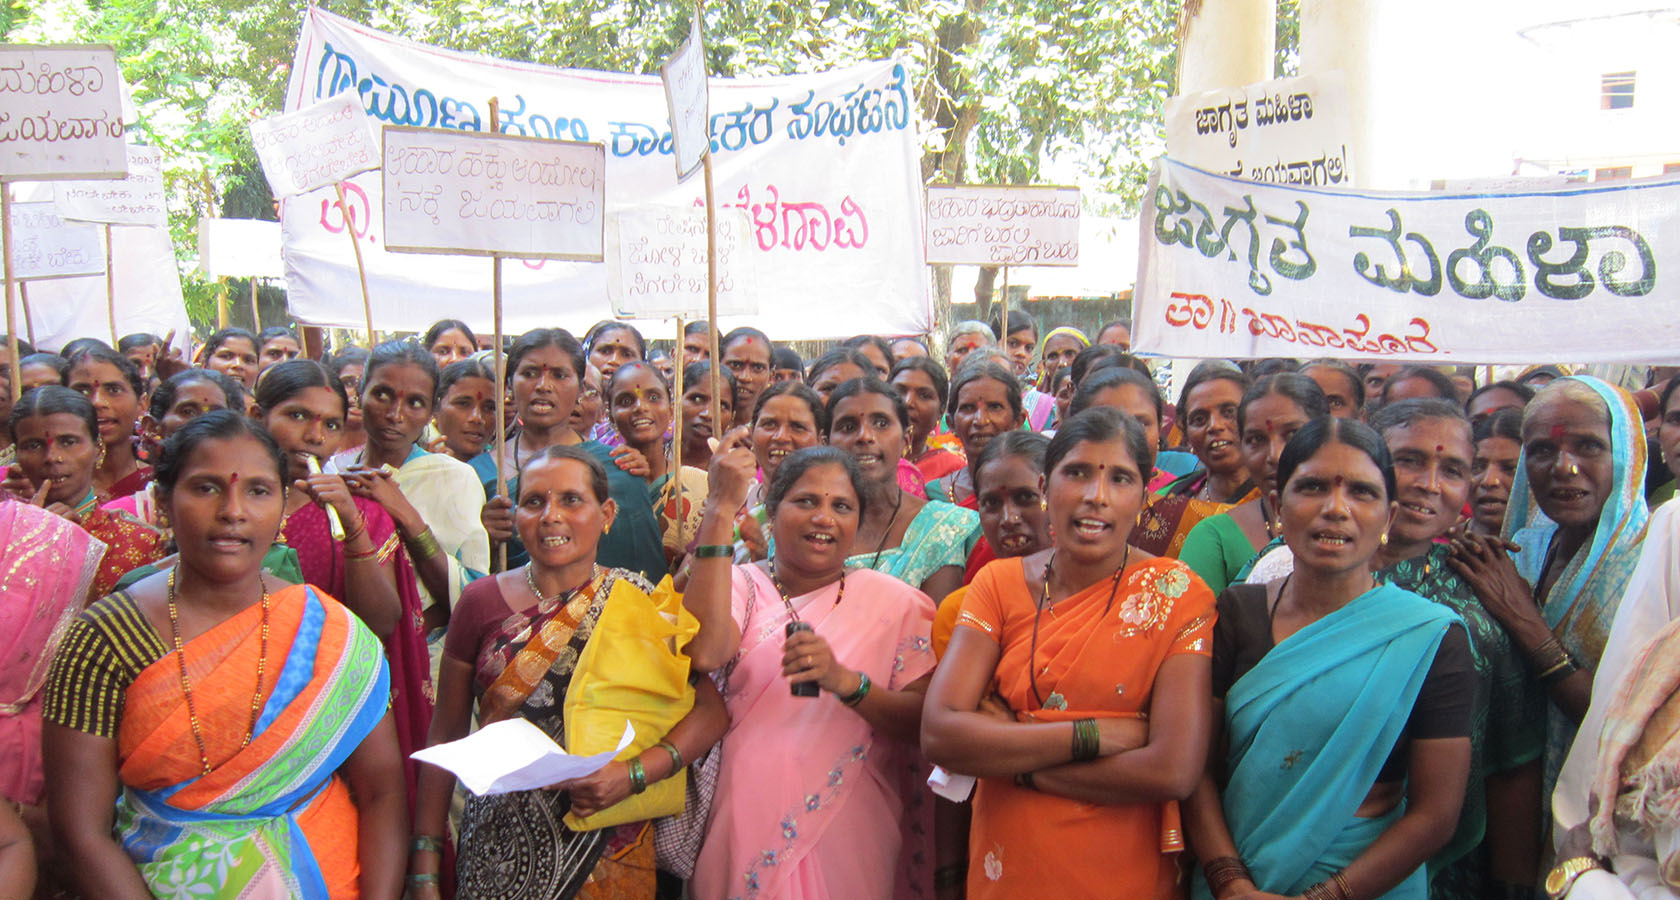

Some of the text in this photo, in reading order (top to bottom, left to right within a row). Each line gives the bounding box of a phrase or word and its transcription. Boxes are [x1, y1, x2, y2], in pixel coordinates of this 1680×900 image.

[0, 59, 104, 96] ಮಹಿಳಾ
[787, 64, 909, 147] ಸಂಘಟನೆ
[1195, 89, 1314, 148] ಜಾಗೃತ ಮಹಿಳಾ
[387, 144, 457, 176] ಆಹಾರ
[458, 148, 508, 191] ಹಕ್ಕು
[458, 190, 596, 225] ಜಯವಾಗಲಿ
[928, 195, 979, 220] ಆಹಾರ
[932, 223, 1030, 248] ಜಾರಿಗೆ ಬರಲಿ
[990, 239, 1042, 264] ಜಾರಿಗೆ
[1153, 184, 1657, 303] ಜಾಗೃತ ಮಹಿಳಾ
